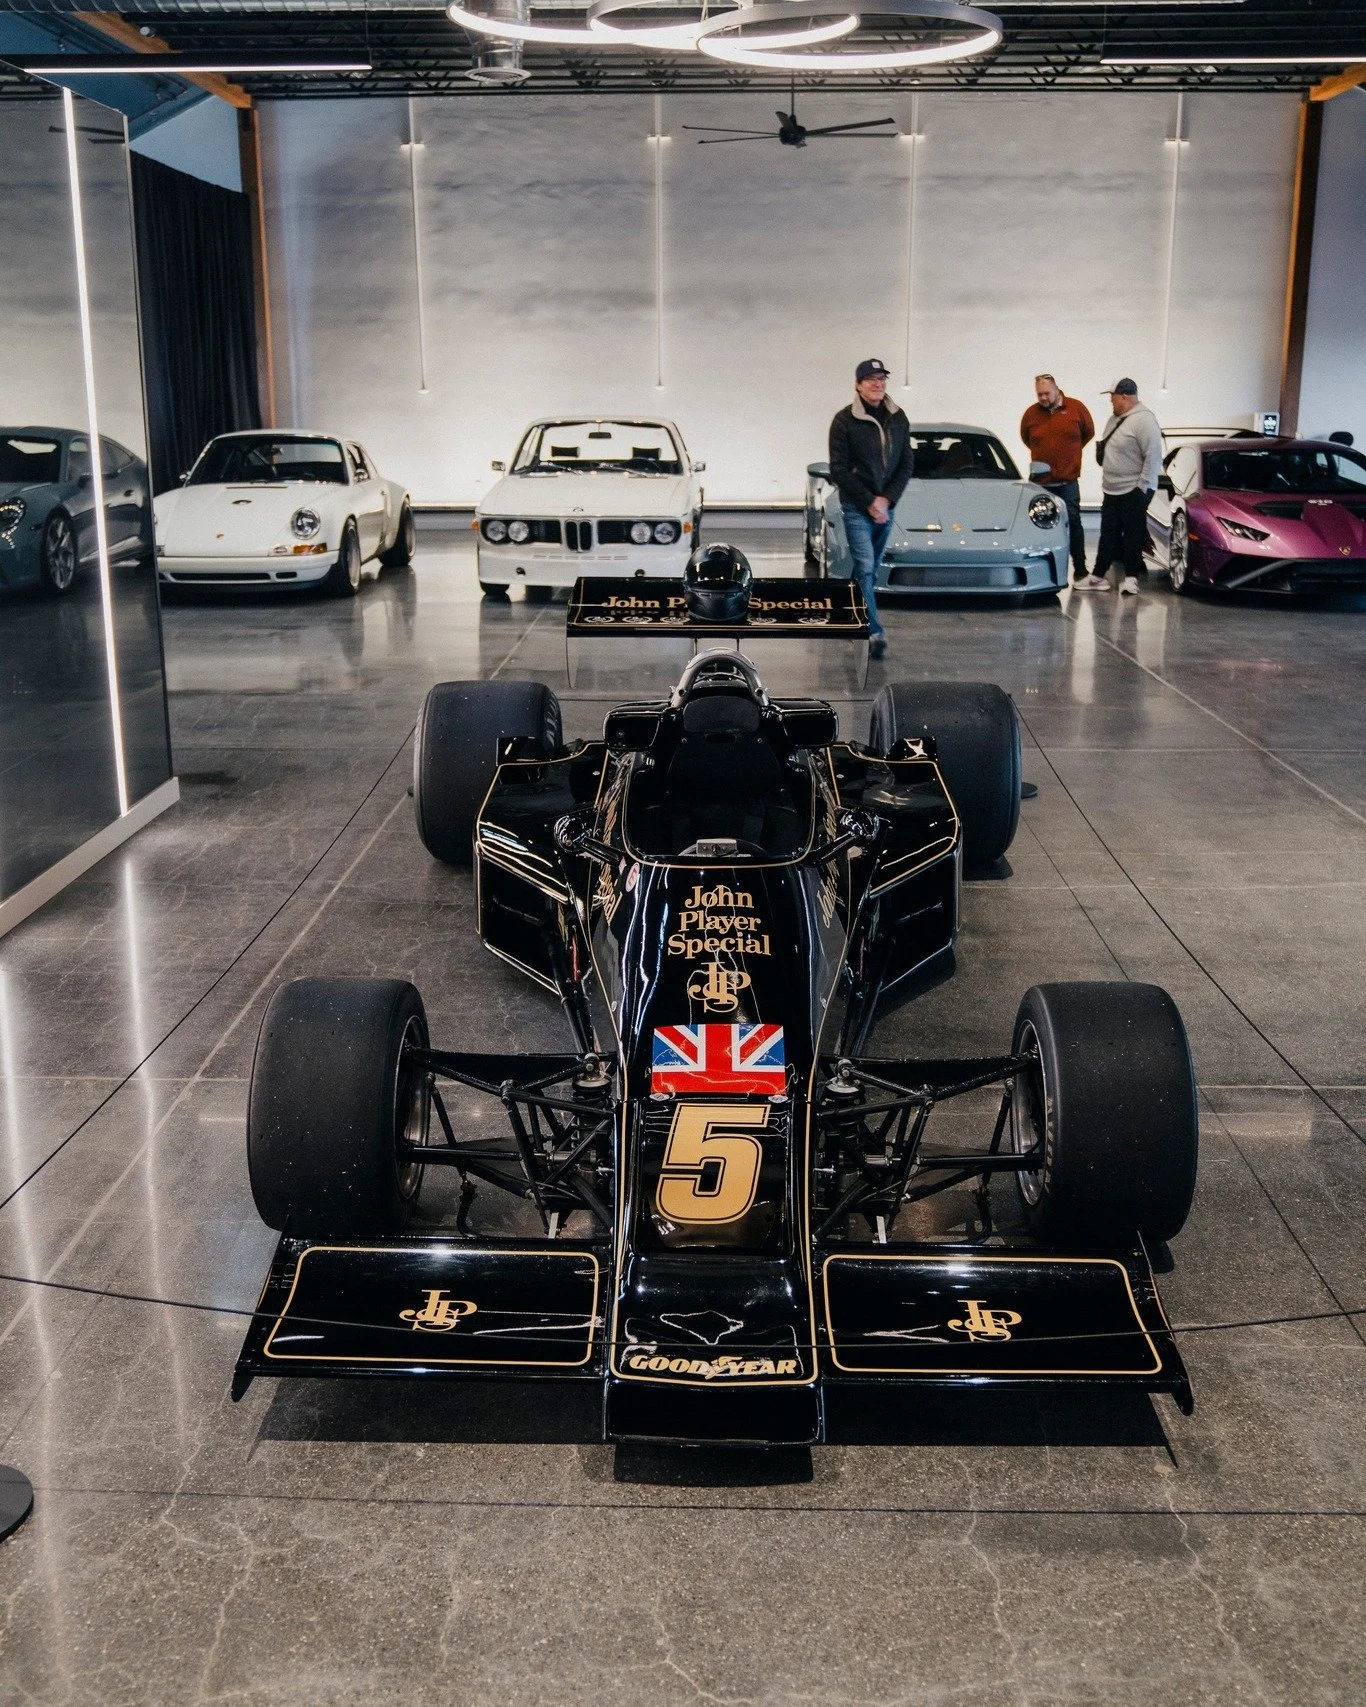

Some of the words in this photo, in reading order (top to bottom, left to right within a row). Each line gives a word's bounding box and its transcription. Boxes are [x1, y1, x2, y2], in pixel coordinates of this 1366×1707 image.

[606, 596, 660, 609] John
[748, 598, 833, 610] Special
[684, 885, 755, 909] John
[678, 910, 762, 935] Player
[667, 931, 772, 960] Special
[655, 1102, 772, 1225] 5
